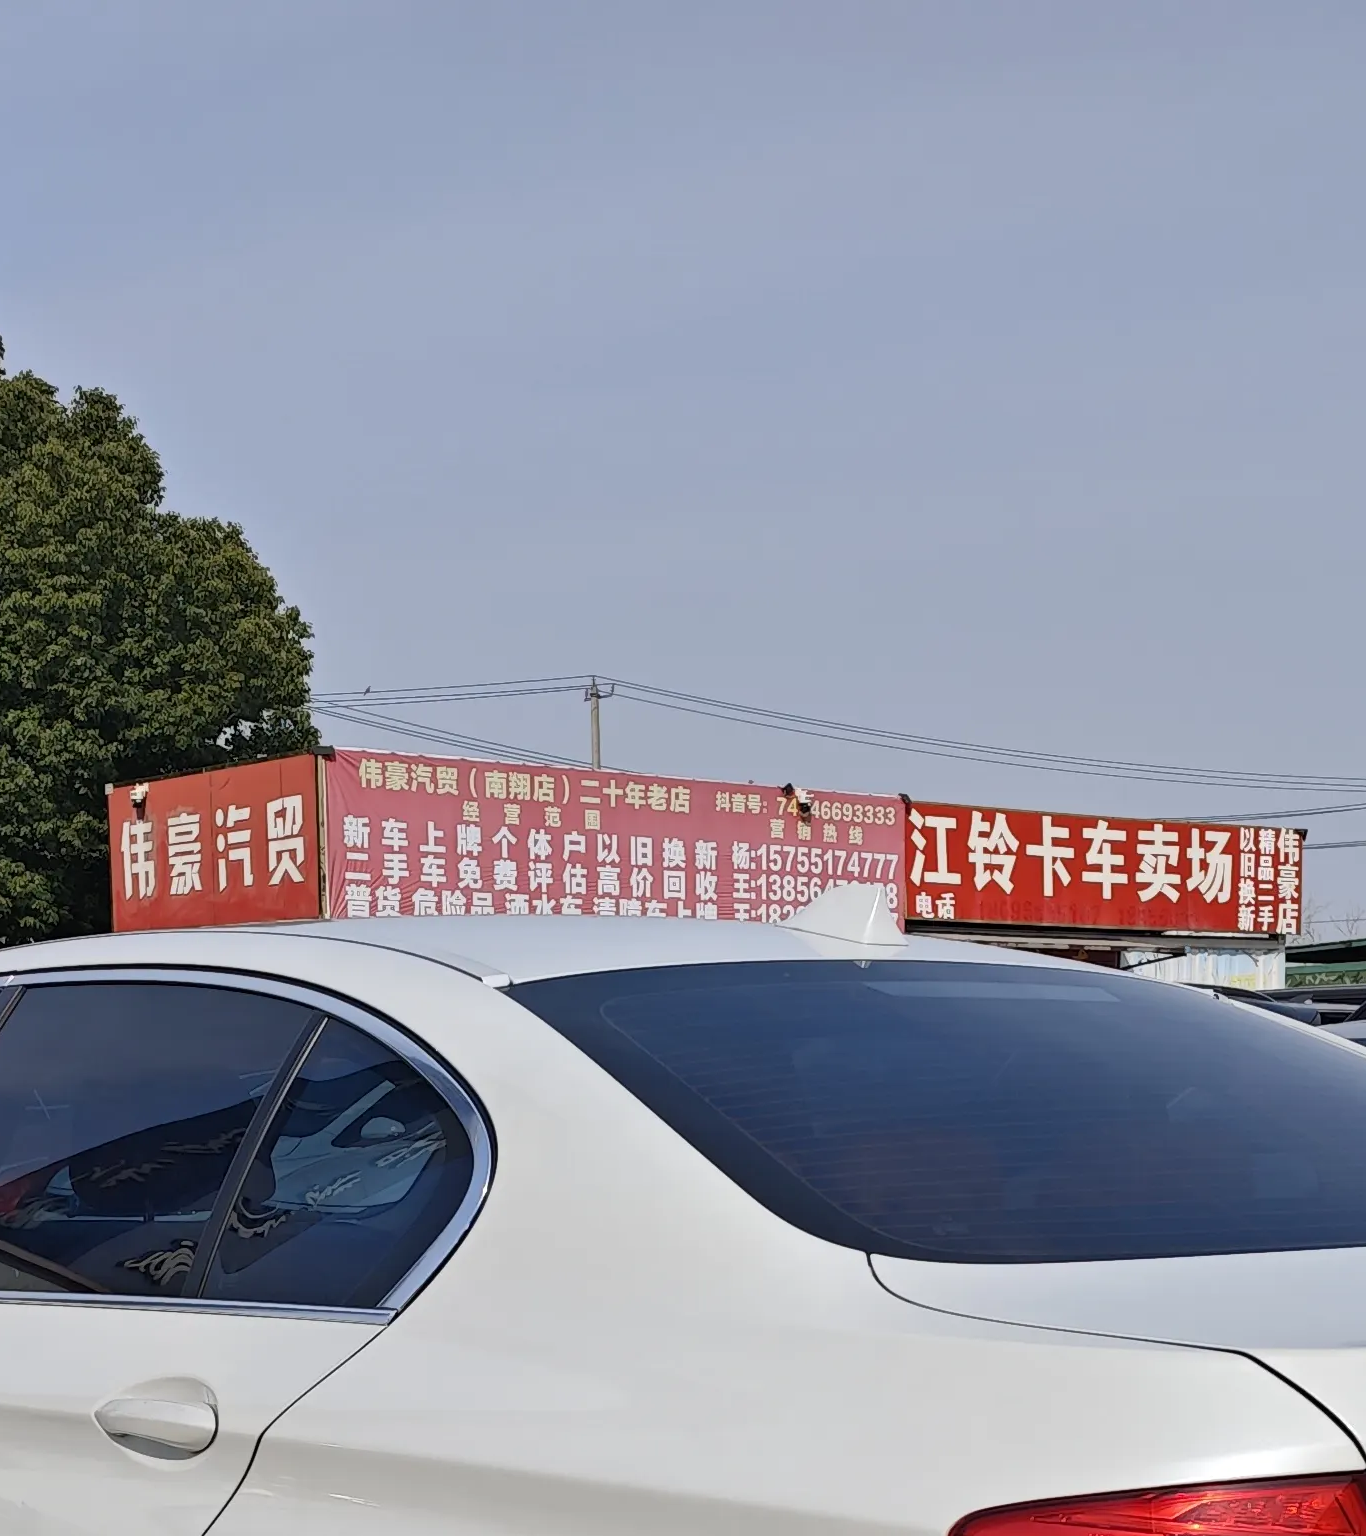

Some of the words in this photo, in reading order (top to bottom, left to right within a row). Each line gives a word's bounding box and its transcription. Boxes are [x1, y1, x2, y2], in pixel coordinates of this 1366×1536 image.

[121, 794, 305, 901] 伟豪汽贸
[462, 800, 601, 831] 经营范围
[716, 791, 896, 826] 抖音号：7446693333
[770, 818, 864, 846] 营销热线
[908, 807, 1233, 904] 江铃卡车卖场
[915, 891, 956, 920] 电话
[1237, 826, 1257, 932] 以旧换新
[1257, 828, 1276, 932] 精品二手
[1276, 827, 1300, 935] 伟豪店
